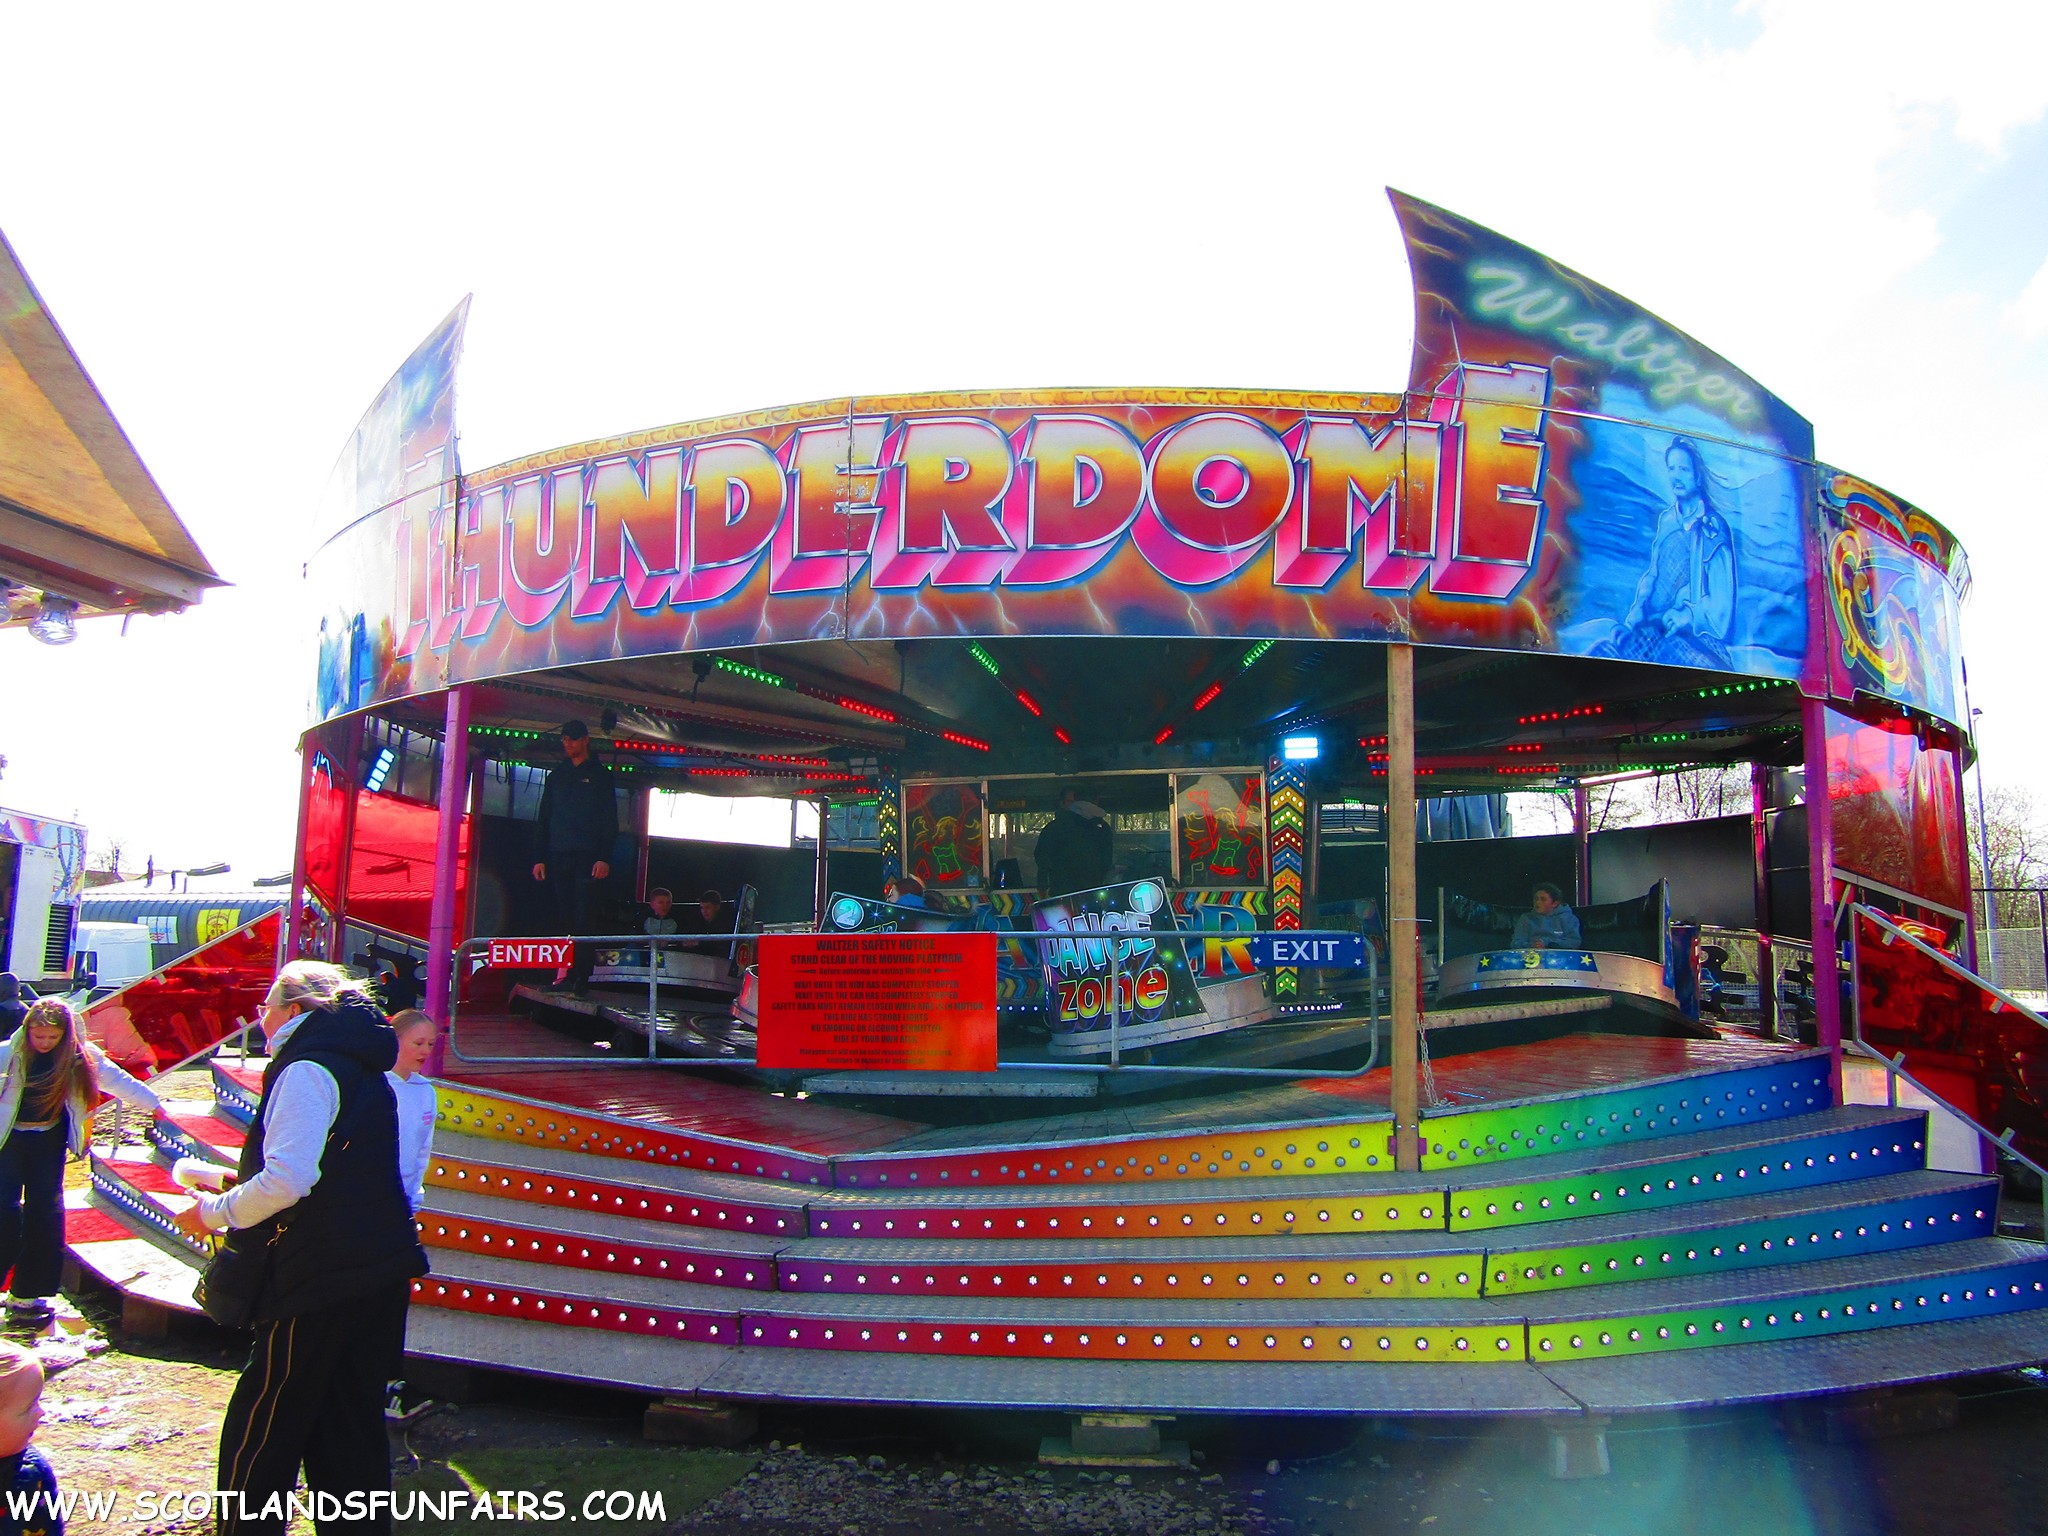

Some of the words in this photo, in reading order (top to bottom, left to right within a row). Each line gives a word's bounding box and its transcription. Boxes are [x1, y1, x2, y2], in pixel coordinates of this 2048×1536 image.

[1470, 264, 1758, 417] Waltzer
[396, 360, 1552, 658] THUNDERDOME
[493, 945, 568, 963] ENTRY
[816, 939, 859, 950] WALTZER
[861, 939, 896, 950] SAFETY
[899, 939, 935, 950] NOTICE
[1273, 939, 1340, 962] EXIT
[791, 953, 818, 964] STAND
[820, 953, 846, 964] CLEAR
[849, 953, 859, 964] OF
[861, 953, 877, 964] THE
[879, 953, 914, 964] MOVING
[917, 953, 963, 964] PLATFORM
[1058, 967, 1170, 1023] zone
